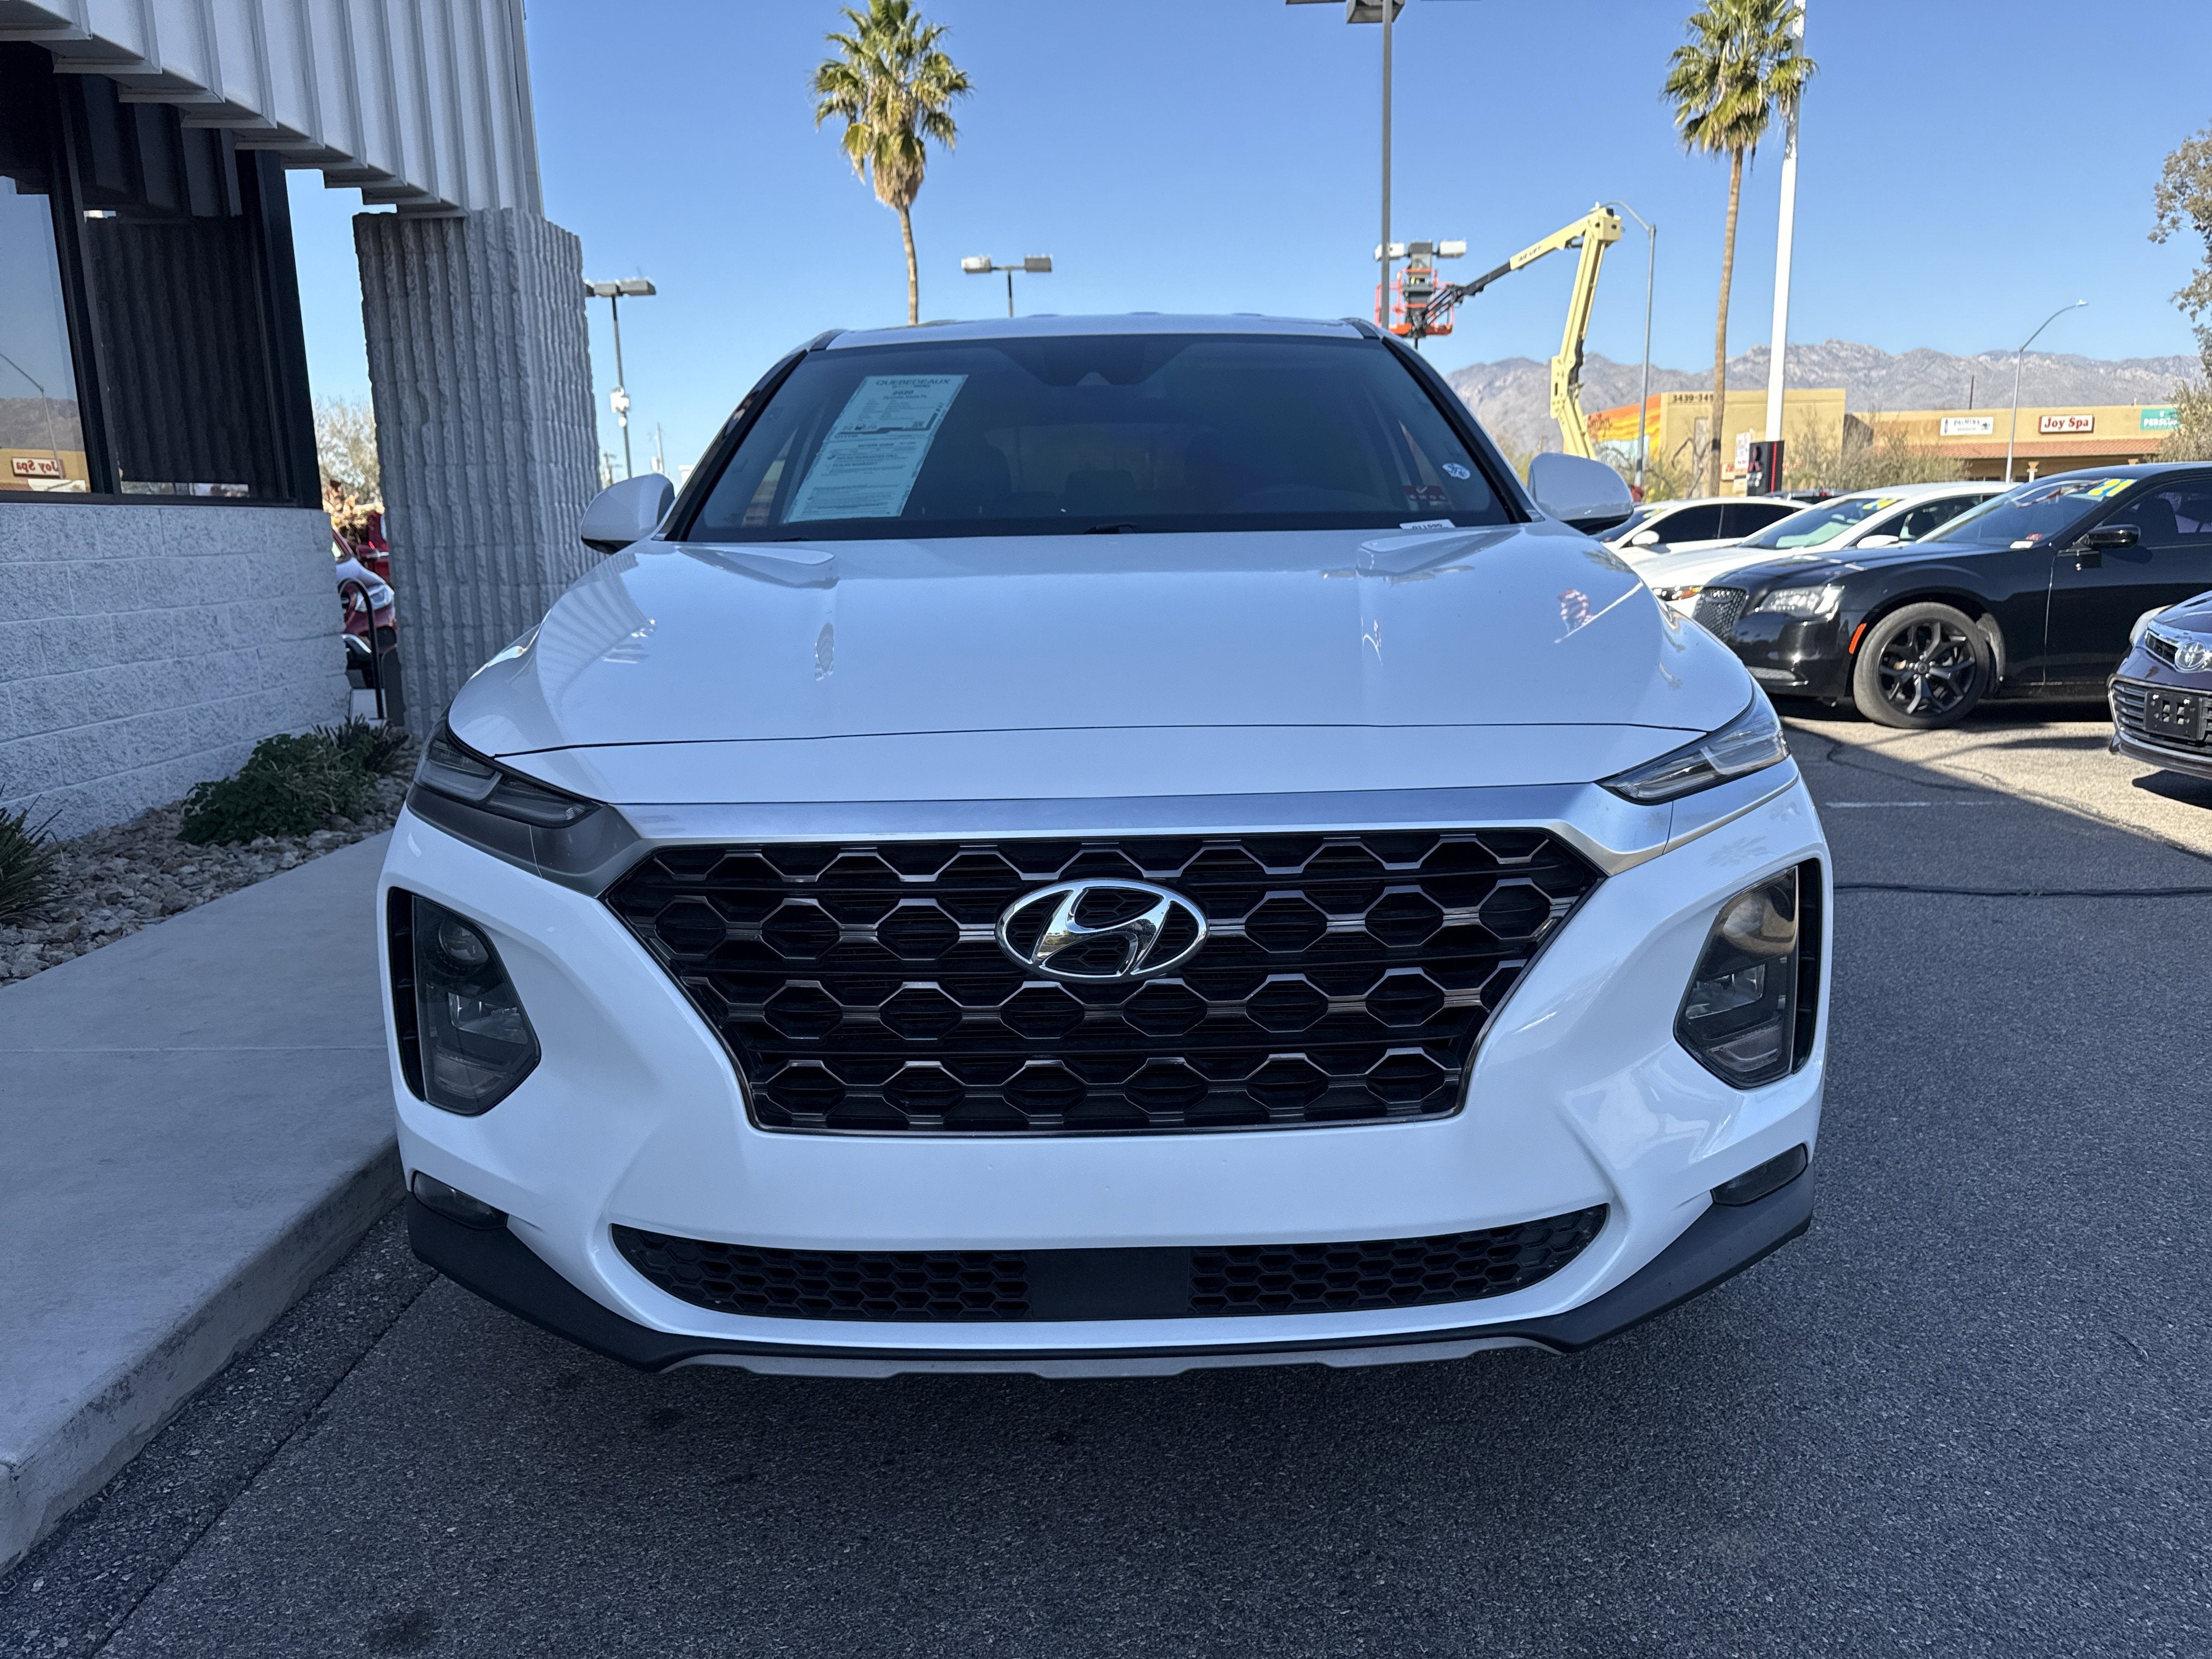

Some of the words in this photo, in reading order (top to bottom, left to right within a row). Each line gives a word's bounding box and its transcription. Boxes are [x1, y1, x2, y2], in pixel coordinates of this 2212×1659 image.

[2044, 417, 2064, 429] Joy
[2068, 417, 2089, 428] Spa
[2088, 478, 2134, 496] 21
